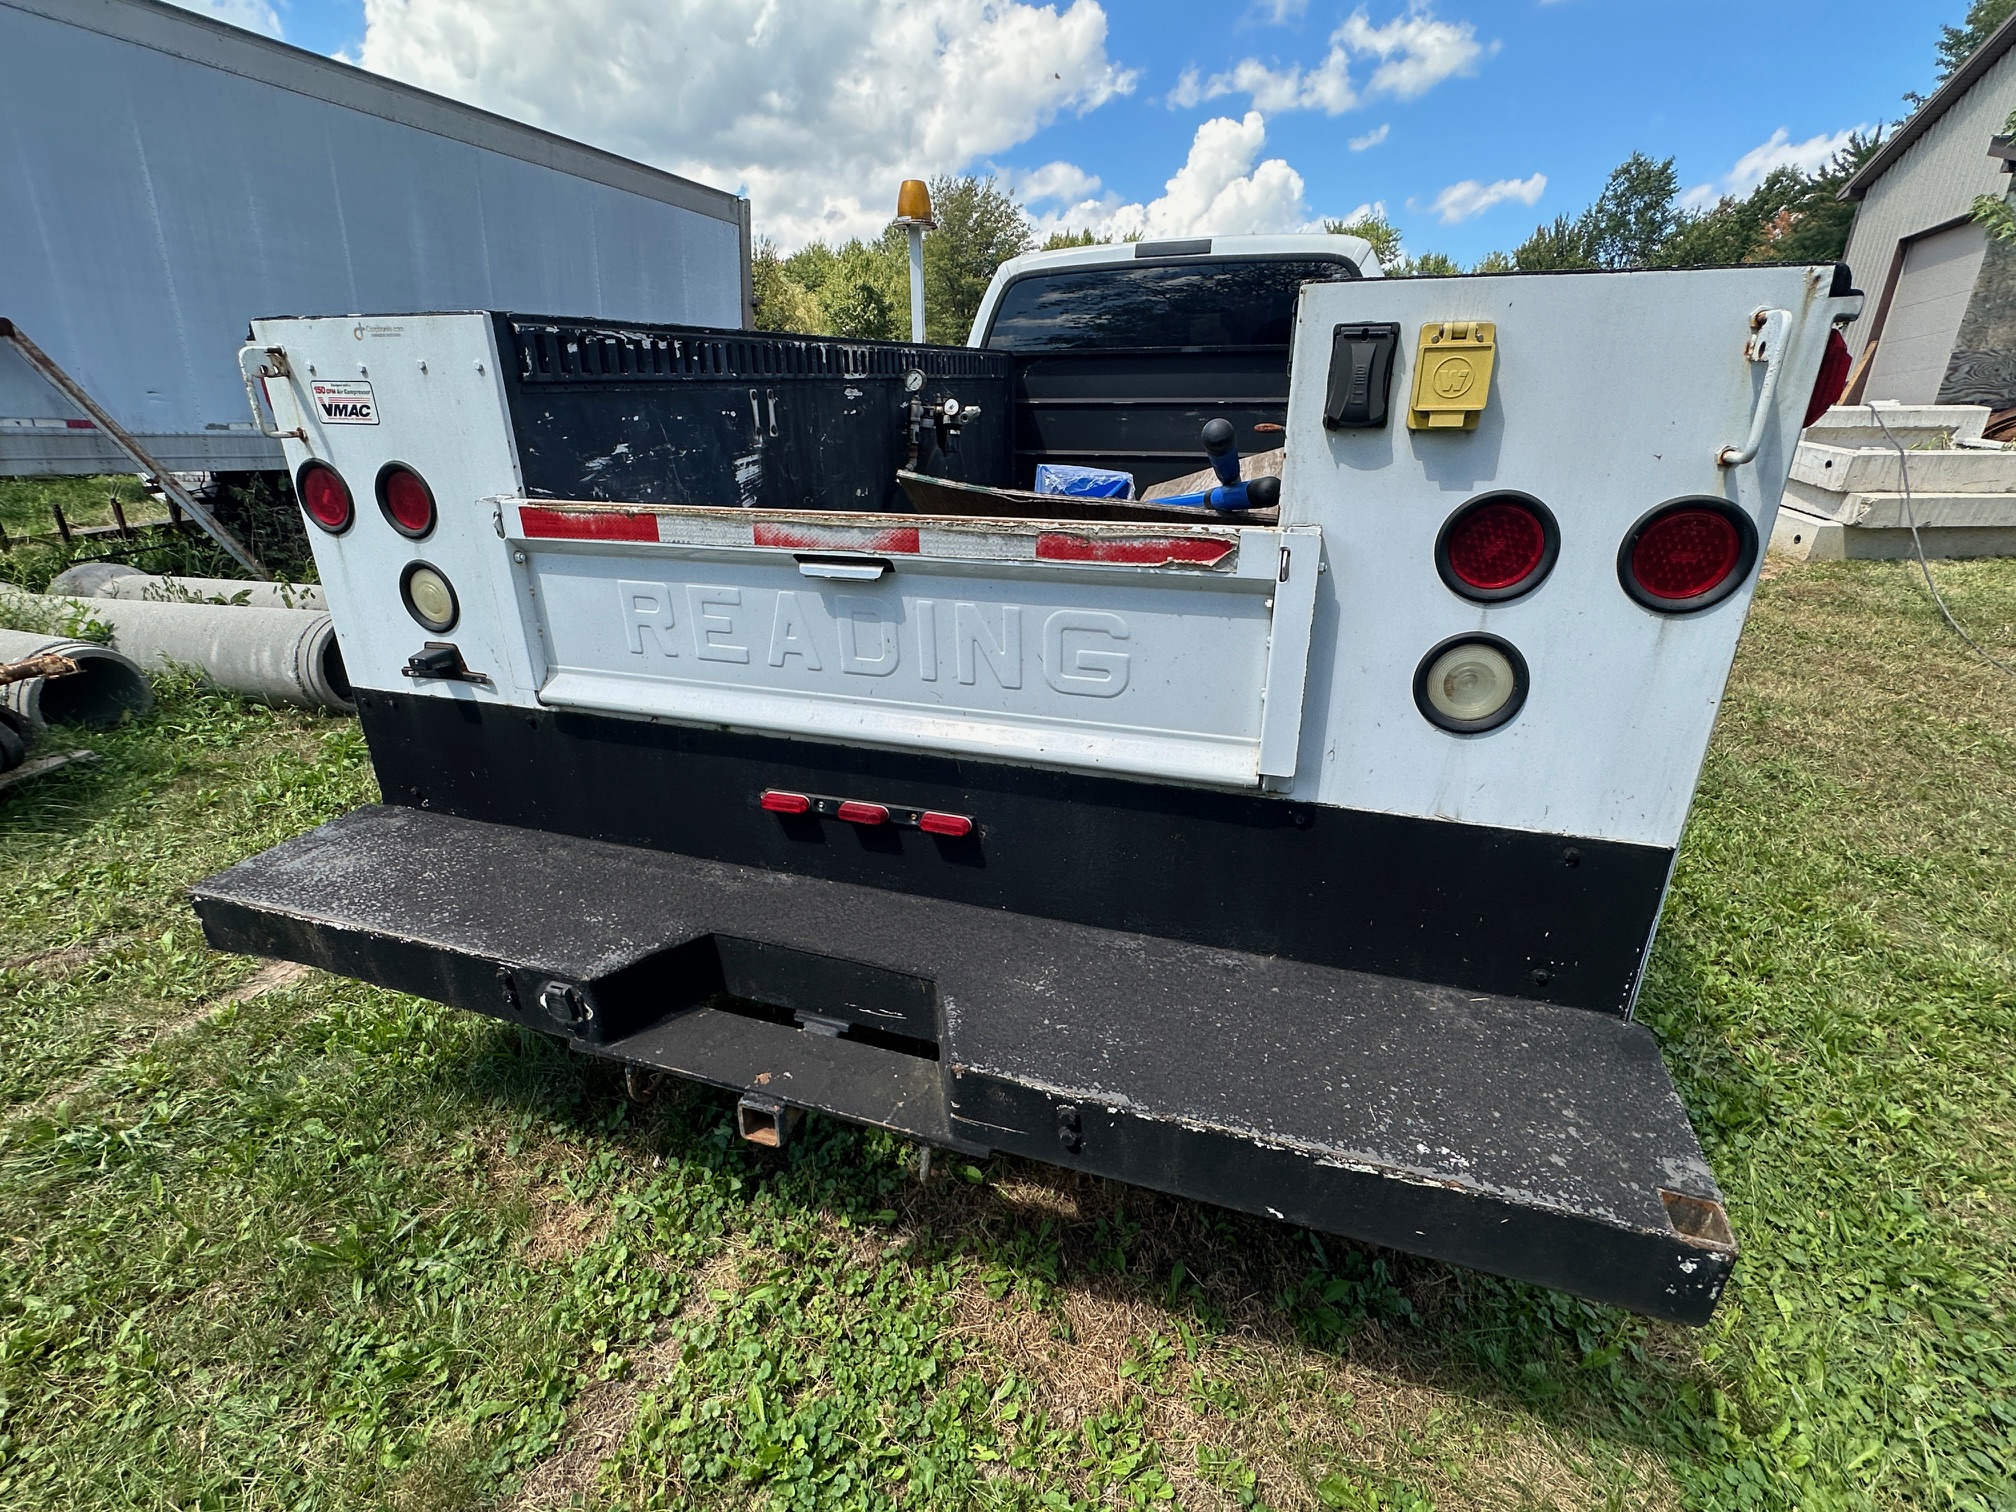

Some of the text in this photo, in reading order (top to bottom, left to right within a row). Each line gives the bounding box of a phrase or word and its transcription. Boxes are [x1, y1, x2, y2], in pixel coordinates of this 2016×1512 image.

[314, 386, 326, 394] 150
[320, 403, 371, 417] VMAC
[617, 579, 1131, 697] READING
